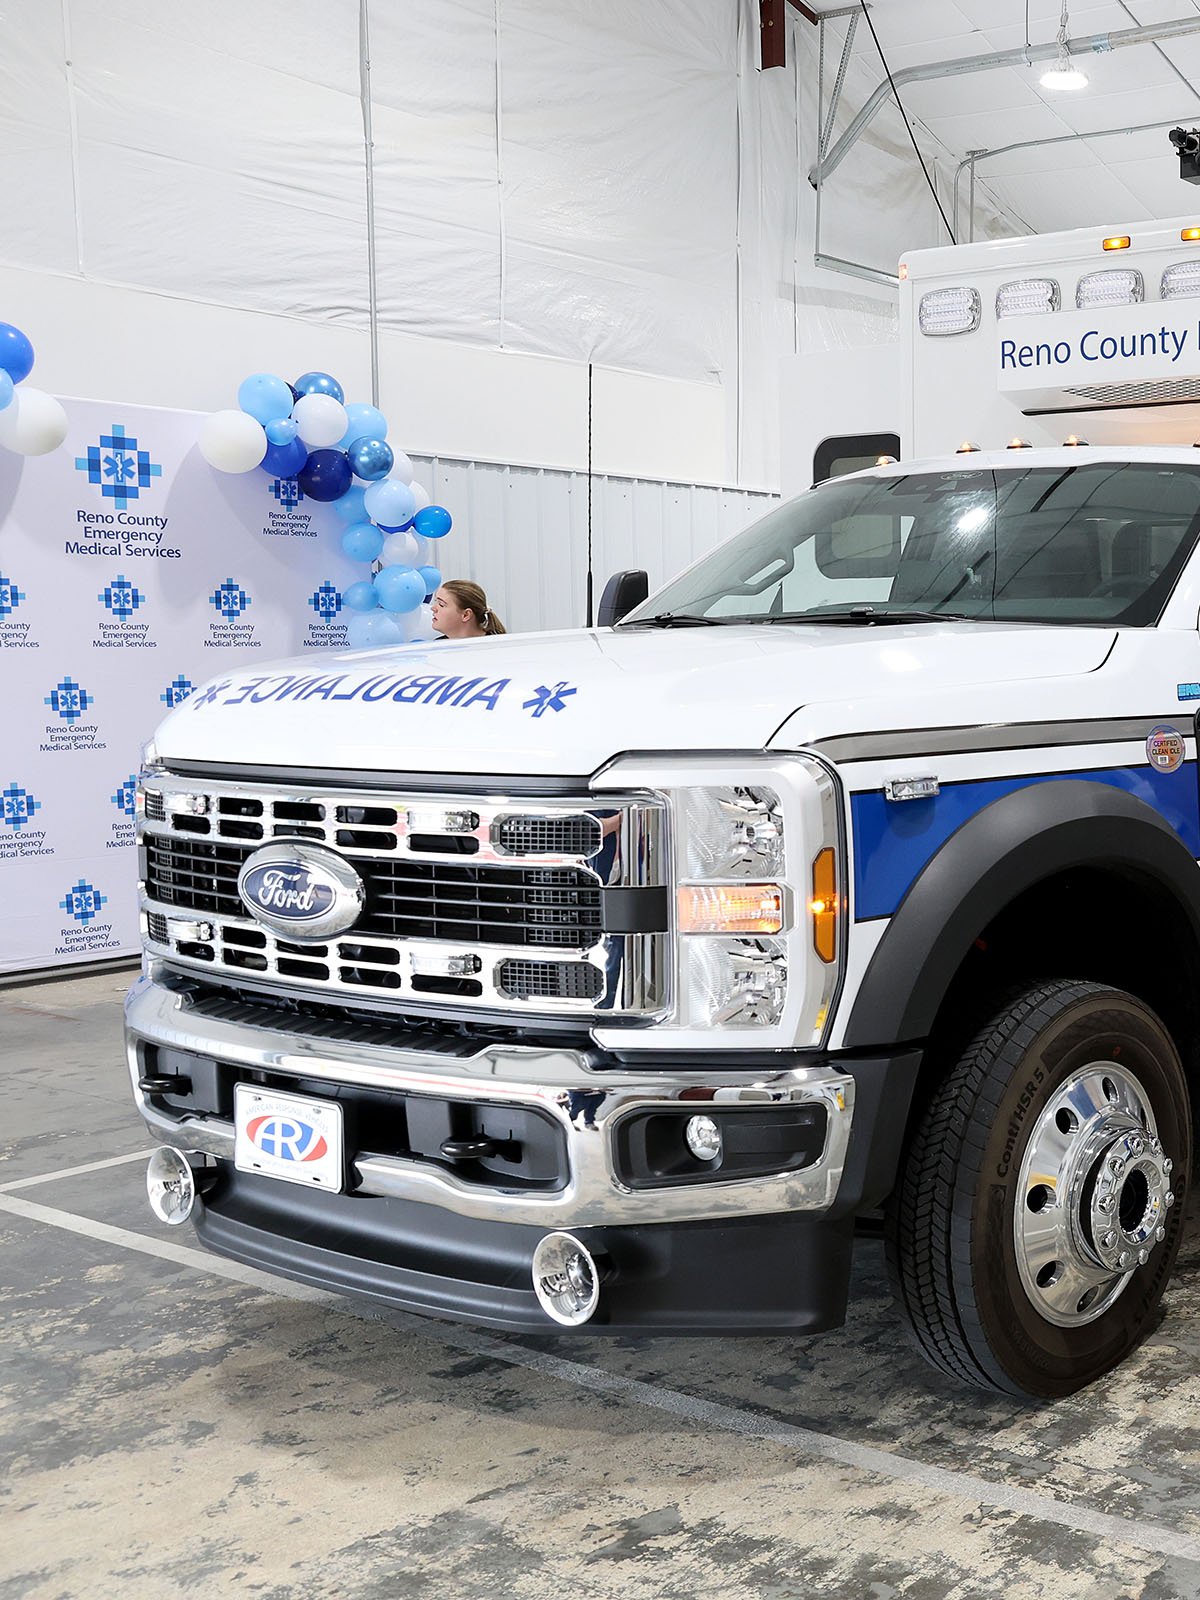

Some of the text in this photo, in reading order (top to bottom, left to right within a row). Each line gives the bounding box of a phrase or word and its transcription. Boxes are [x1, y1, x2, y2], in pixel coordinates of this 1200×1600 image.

[1001, 339, 1072, 369] Reno
[1080, 326, 1188, 362] County
[76, 509, 169, 530] Reno County
[268, 512, 312, 522] Reno County
[271, 520, 310, 530] Emergency
[84, 526, 163, 544] Emergency
[263, 527, 318, 538] Medical Services
[65, 541, 181, 559] Medical Services
[98, 623, 150, 633] Reno County
[209, 623, 255, 633] Reno County
[308, 623, 348, 632] Reno County
[102, 632, 147, 641] Emergency
[212, 632, 252, 640] Emergency
[311, 631, 347, 640] Emergency
[4, 640, 40, 648] Services
[92, 640, 157, 648] Medical Services
[204, 640, 262, 648] Medical Services
[45, 724, 98, 734] Reno County
[50, 733, 96, 743] Emergency
[40, 741, 107, 752] Medical Services
[112, 823, 132, 831] Reno
[15, 831, 46, 840] County
[0, 840, 43, 850] mergency
[106, 838, 136, 848] Medical
[20, 848, 55, 857] Services
[258, 869, 315, 911] Ford
[60, 923, 112, 937] Reno County
[65, 932, 110, 944] Emergency
[55, 939, 120, 954] Medical Services
[1014, 1081, 1038, 1122] HSR
